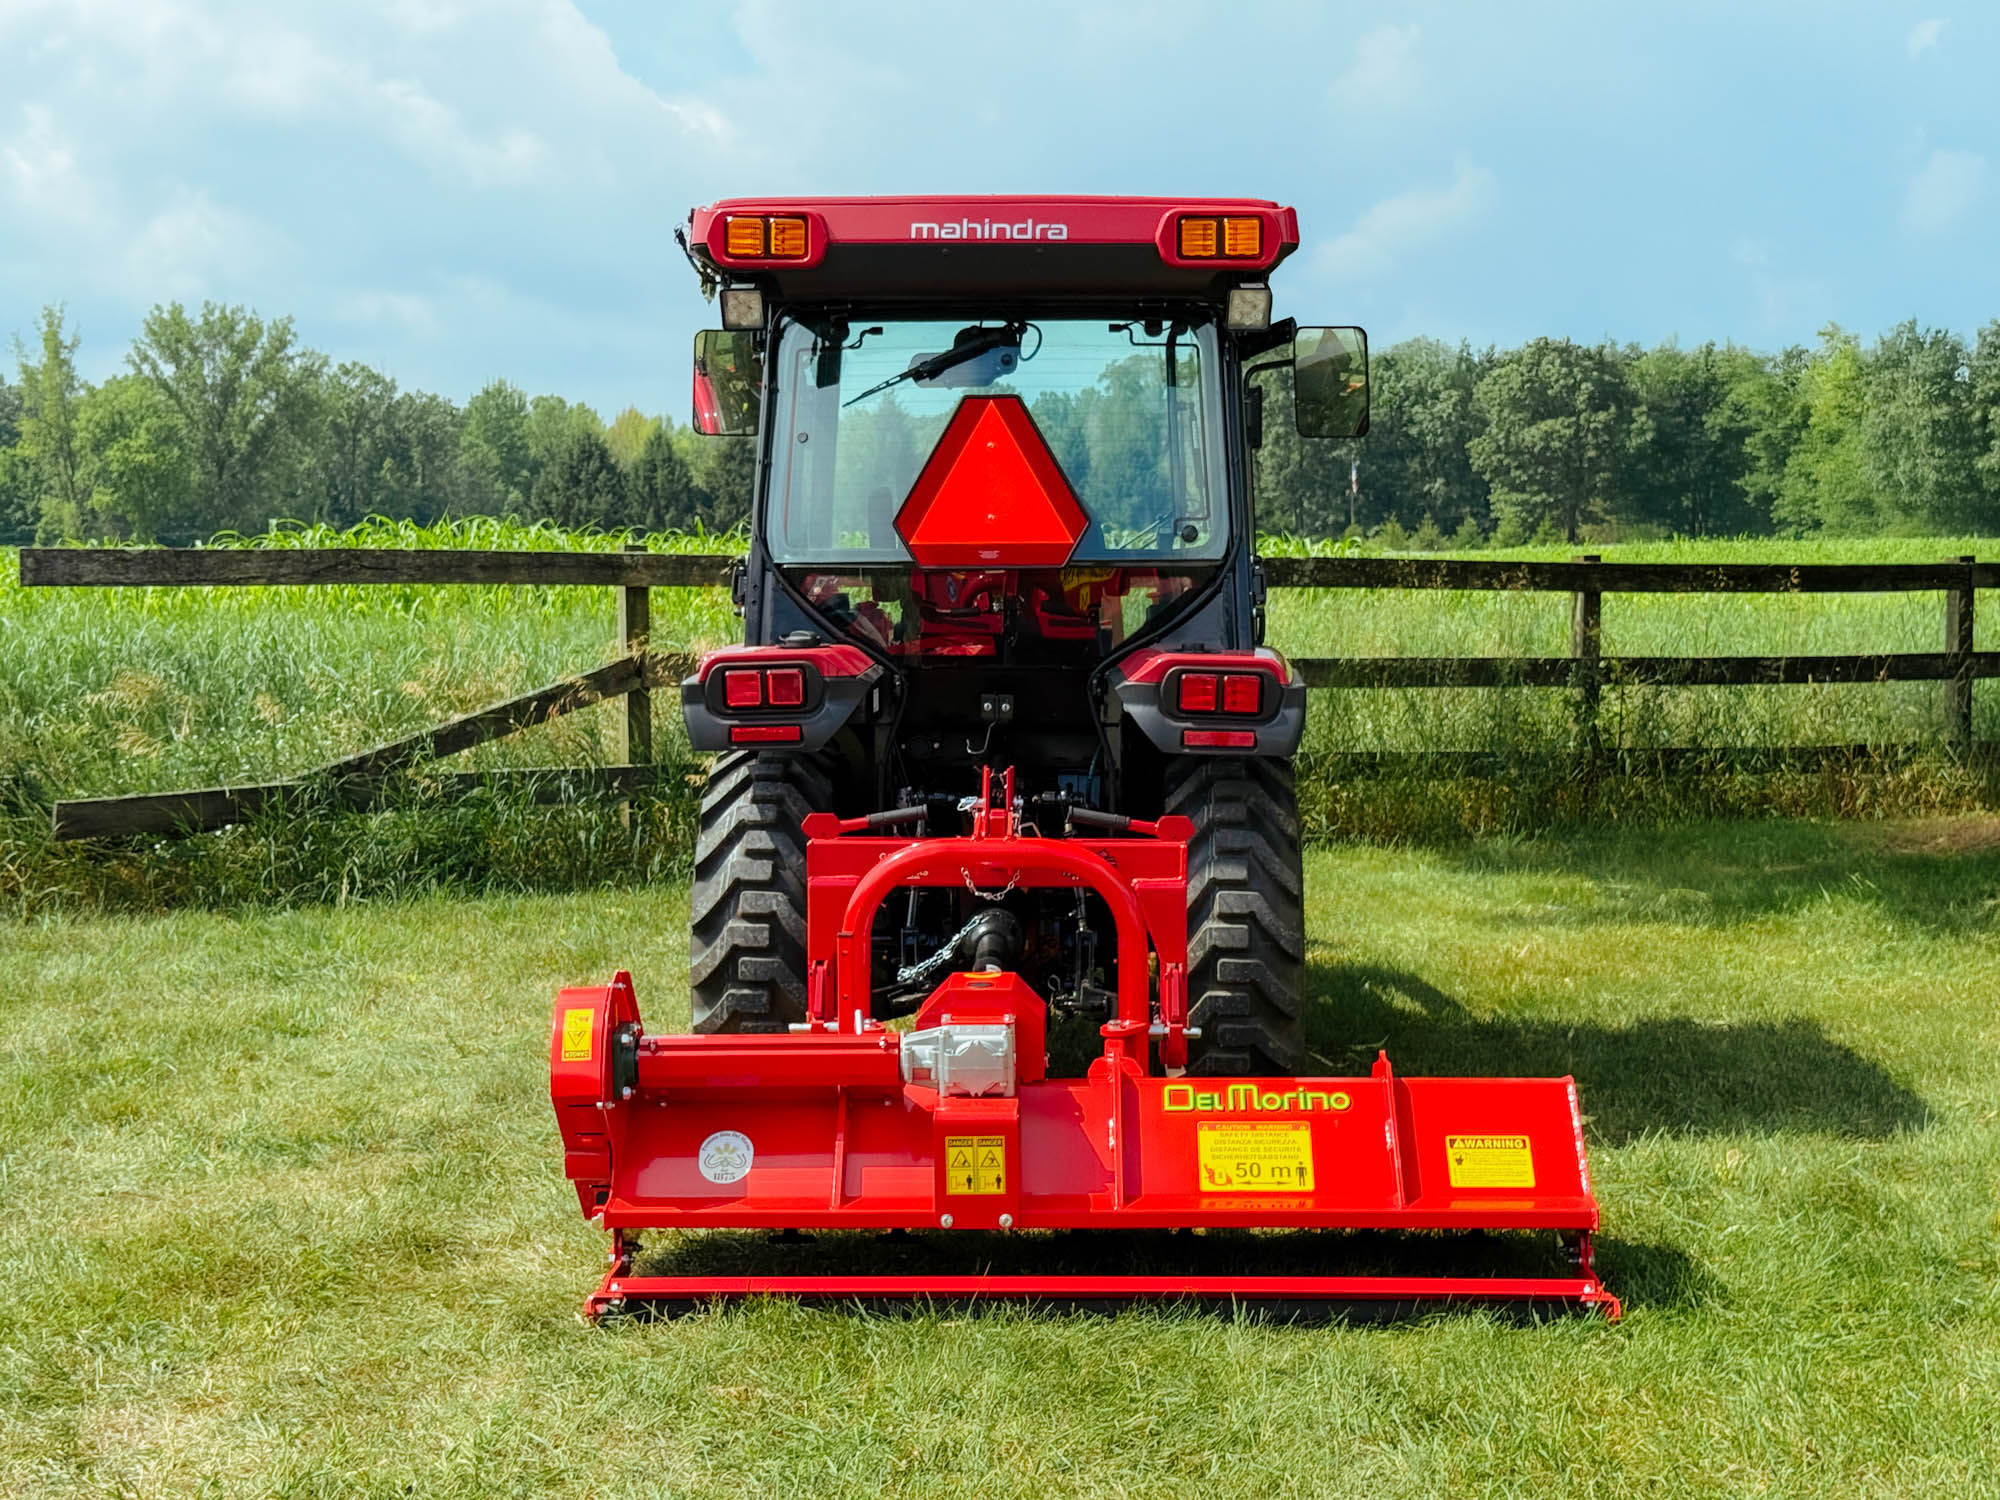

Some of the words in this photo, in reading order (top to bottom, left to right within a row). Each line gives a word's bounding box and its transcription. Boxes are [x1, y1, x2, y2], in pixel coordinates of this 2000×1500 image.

[910, 218, 1068, 240] mahindra
[1464, 1139, 1523, 1148] WARNING
[1235, 1162, 1262, 1178] 50
[1271, 1165, 1292, 1178] m
